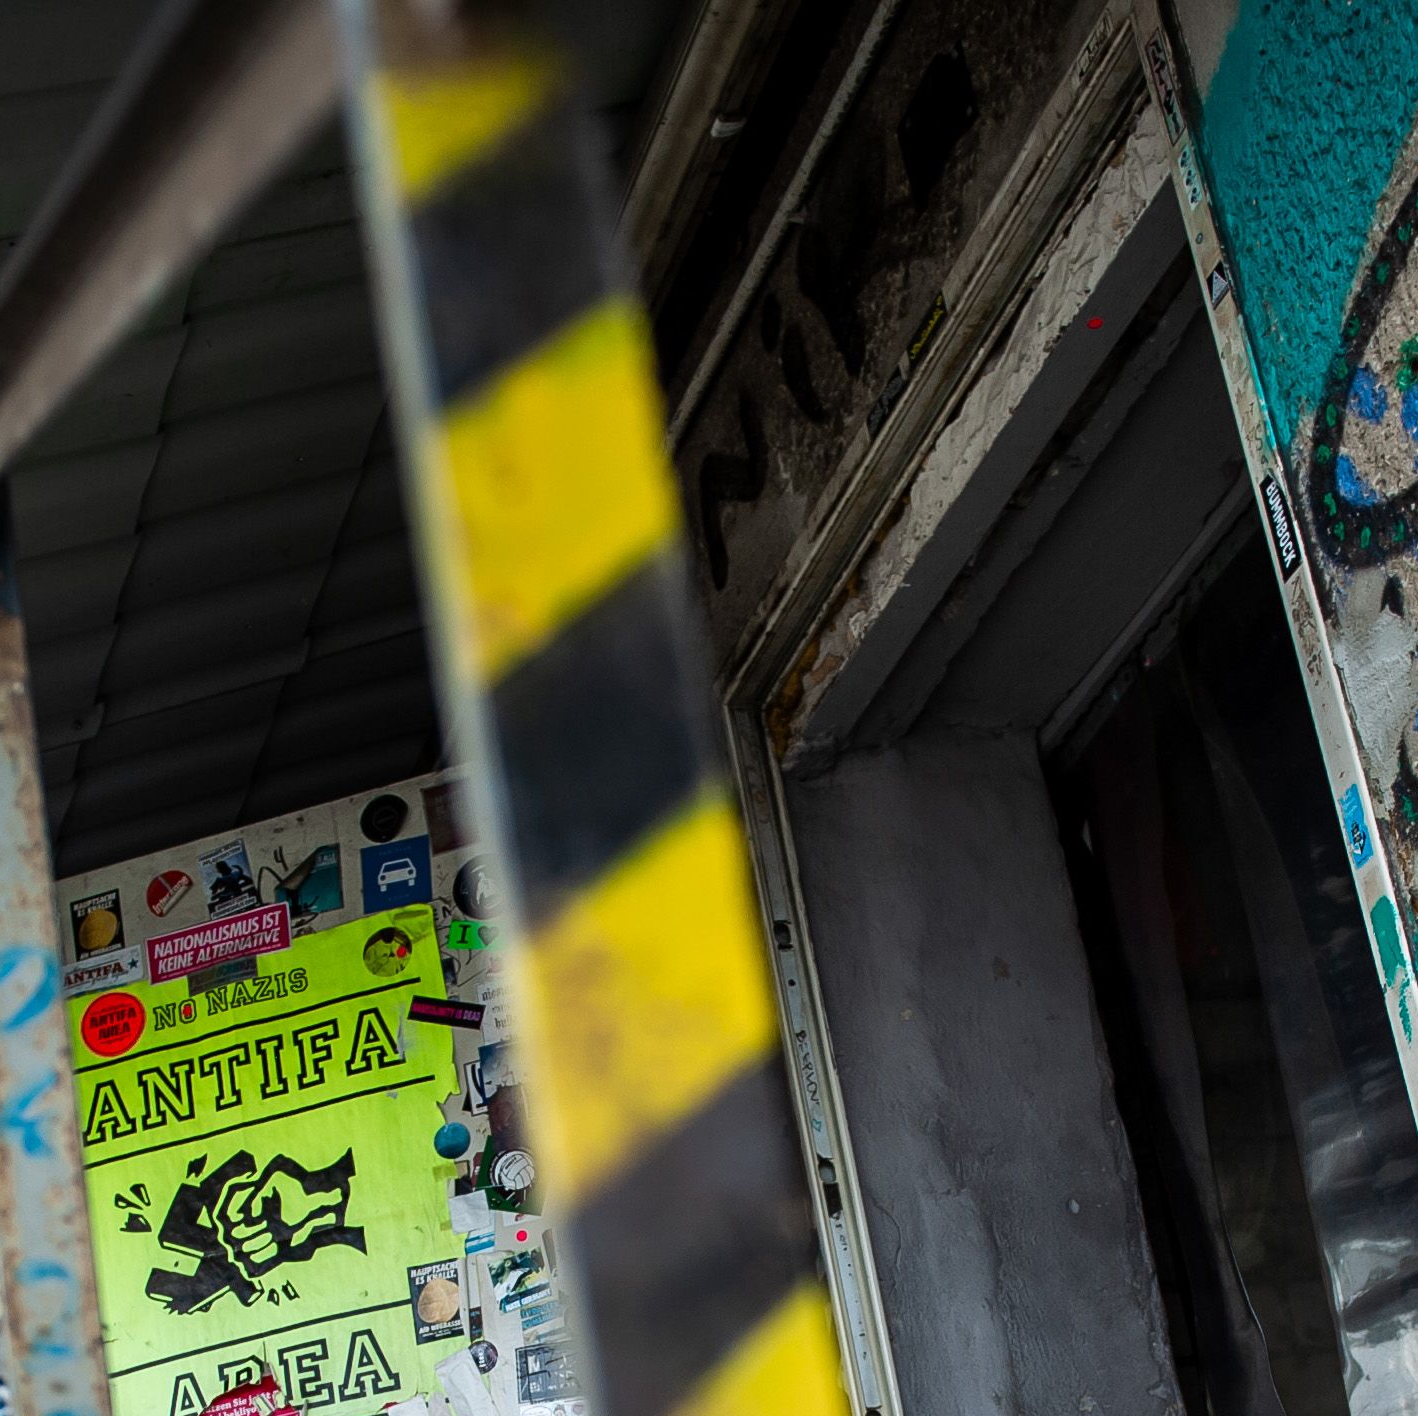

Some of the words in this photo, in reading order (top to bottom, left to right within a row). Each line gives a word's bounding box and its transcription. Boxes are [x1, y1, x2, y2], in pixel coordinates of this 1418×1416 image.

[1265, 481, 1298, 569] BUMMBOCK
[153, 915, 261, 961] NATIONALISMUS
[261, 909, 283, 930] IST
[157, 951, 194, 976] KEINE
[196, 926, 281, 963] ALTERNATIVE
[63, 961, 126, 988] ANTIFA
[152, 998, 198, 1033] NO
[205, 966, 309, 1017] NAZIS
[88, 1005, 138, 1030] ANTIFA
[83, 1006, 407, 1148] ANTIFA
